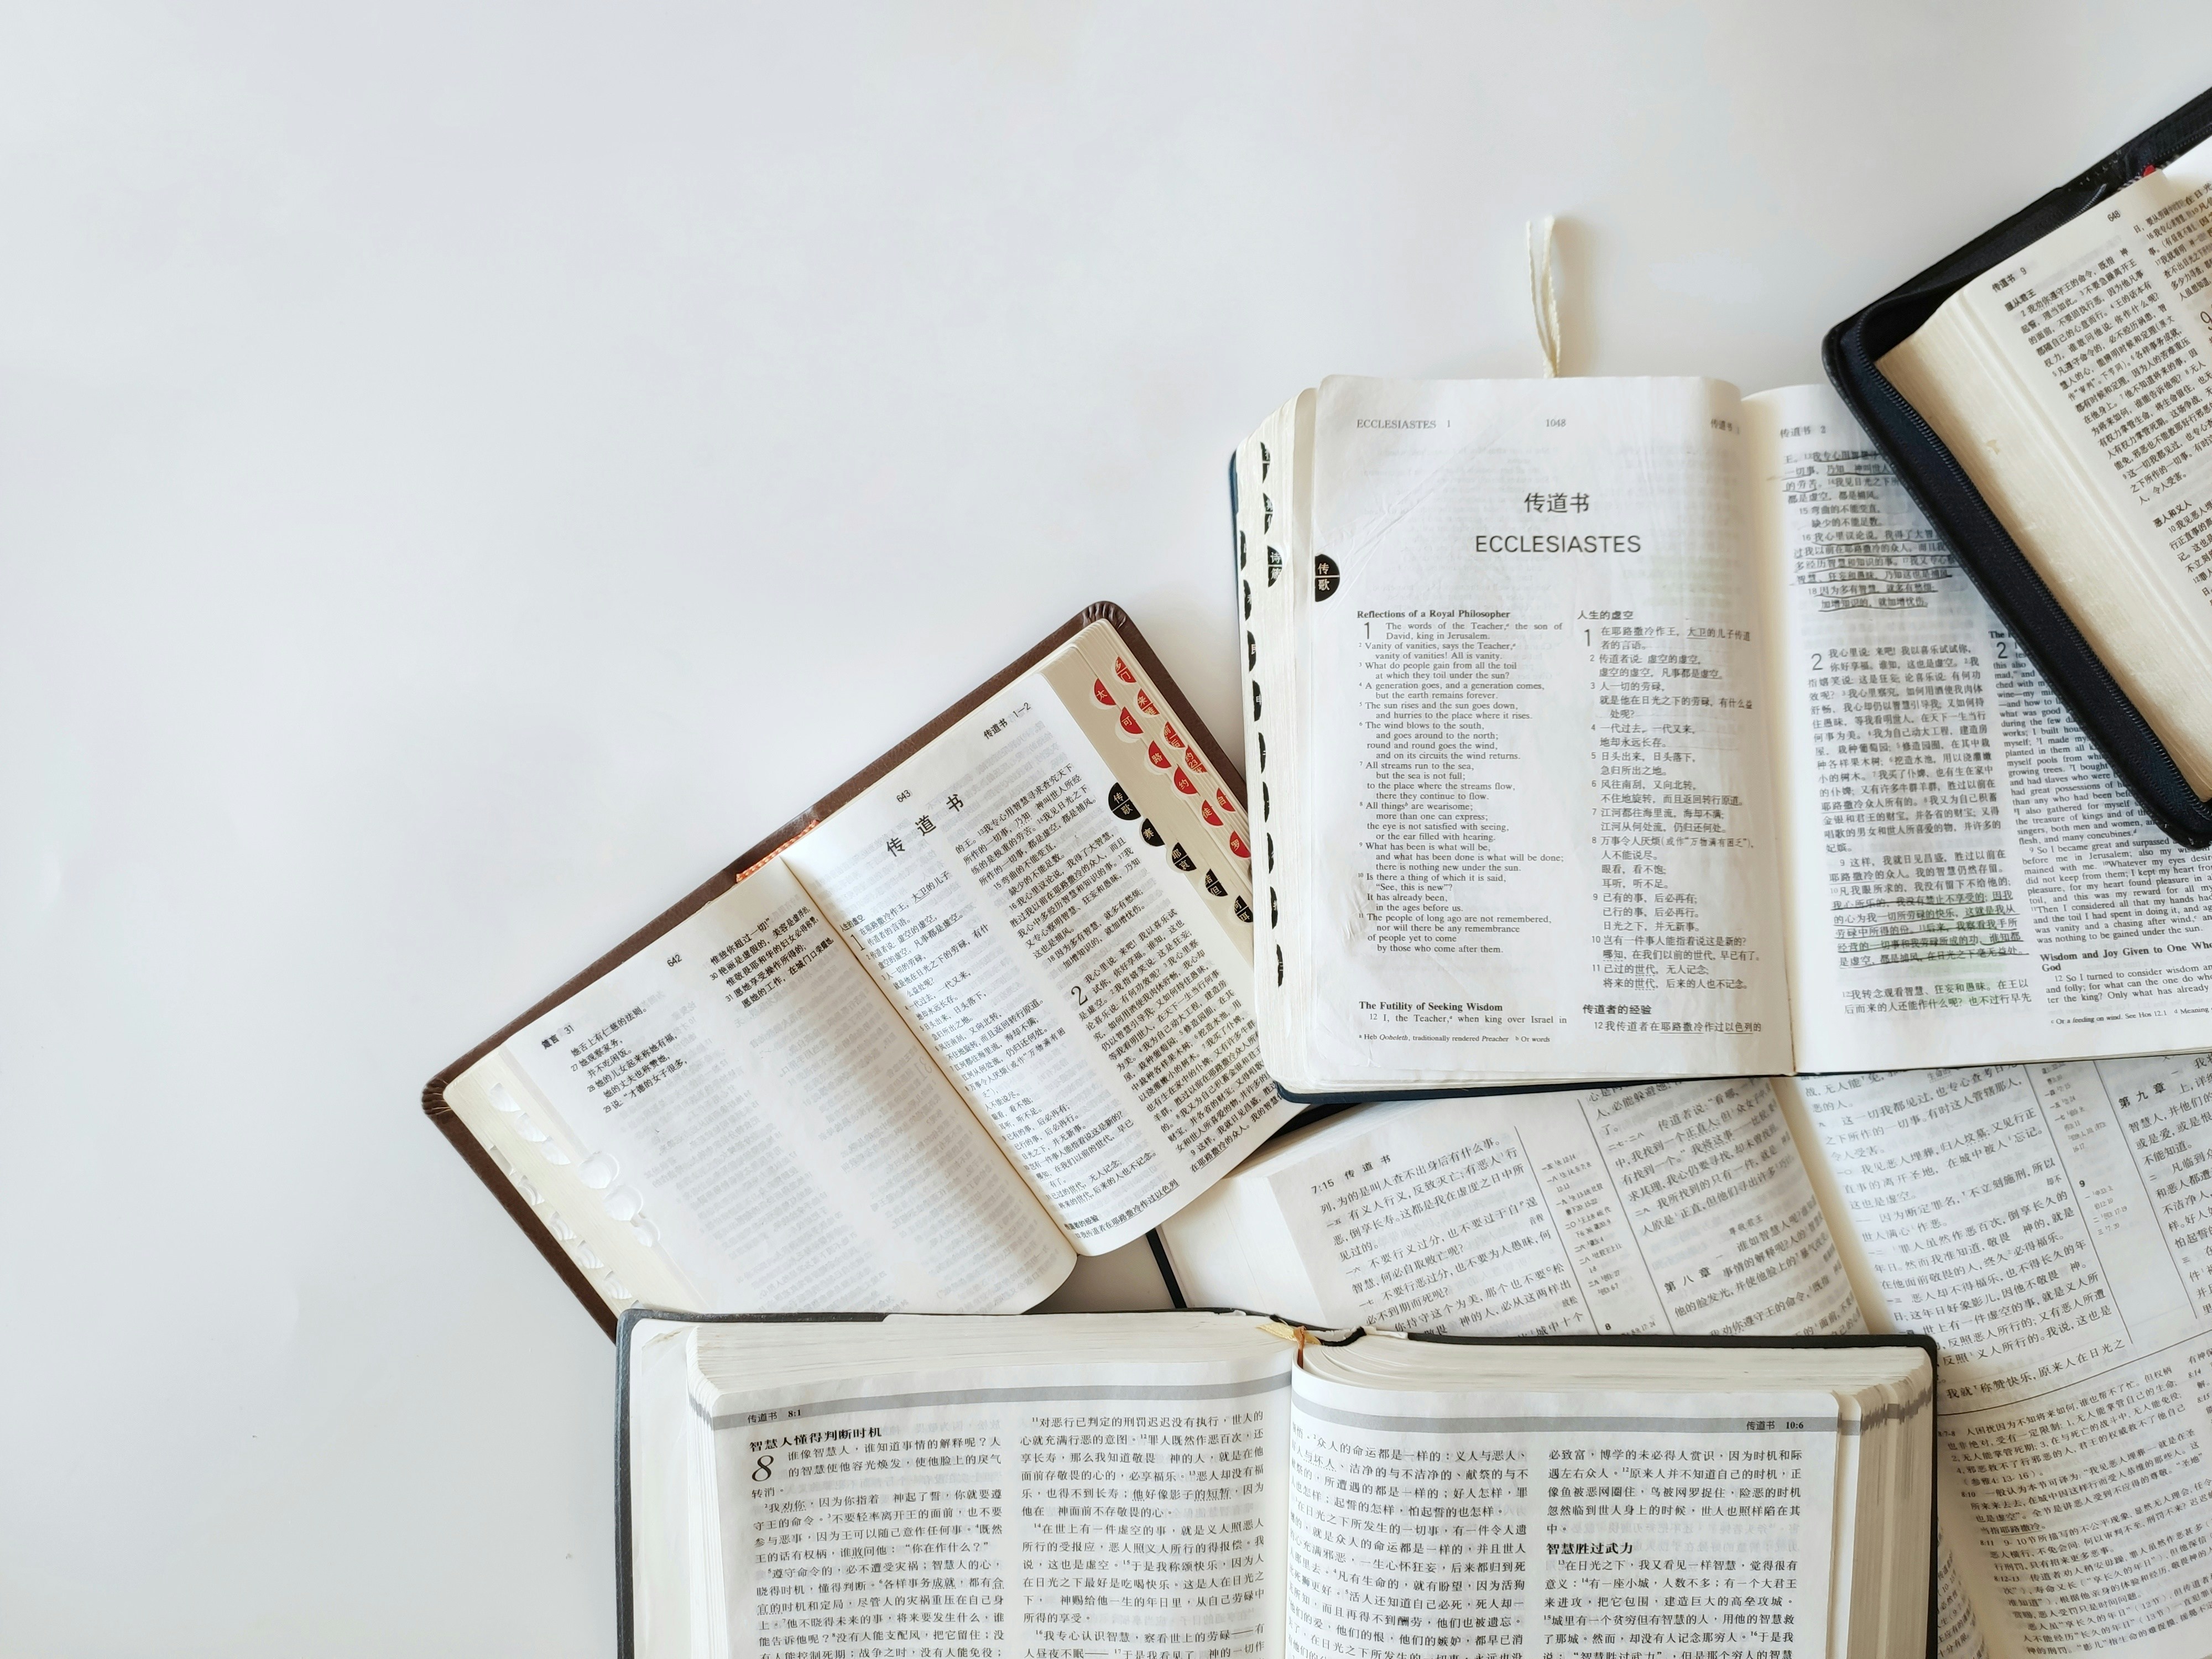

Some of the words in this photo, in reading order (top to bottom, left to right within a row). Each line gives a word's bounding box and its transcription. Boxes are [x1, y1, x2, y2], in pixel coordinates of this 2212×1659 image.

[2107, 210, 2121, 222] 648
[1991, 273, 2016, 293] 传道书
[2020, 267, 2027, 275] 9
[1357, 419, 1437, 429] ECCLESIASTES
[1546, 419, 1566, 427] 1048
[1524, 492, 1590, 514] 传道书
[2152, 500, 2193, 528] 恶人和义人
[1475, 535, 1641, 554] ECCLESIASTES
[1317, 563, 1330, 575] 传
[1317, 579, 1330, 591] 歌
[1357, 610, 1406, 619] Reflections
[1429, 610, 1455, 620] Royal
[1458, 610, 1511, 620] Philosopher
[1577, 610, 1634, 620] 人生的虚空
[1364, 622, 1370, 640] 1
[1386, 632, 1413, 641] David,
[1416, 632, 1434, 641] king
[1437, 632, 1445, 640] in
[1447, 632, 1490, 640] Jerusalem.
[1584, 629, 1590, 646] 1
[1600, 640, 1646, 650] 者的言语。
[1364, 661, 1387, 670] What
[1402, 661, 1431, 671] people
[1432, 661, 1450, 671] gain
[1488, 661, 1501, 670] the
[1503, 661, 1517, 670] toil
[1811, 653, 1823, 671] 2
[1375, 681, 1419, 691] generation
[1421, 683, 1443, 691] goes,
[1470, 681, 1514, 691] generation
[1096, 690, 1108, 701] 太
[1137, 696, 1147, 707] 来
[1375, 691, 1389, 700] but
[1392, 691, 1405, 699] the
[1407, 691, 1429, 699] earth
[1432, 691, 1464, 699] remains
[1466, 691, 1499, 699] forever.
[1121, 716, 1133, 726] 可
[983, 718, 1008, 740] 传道书
[1599, 737, 1667, 748] 地却永远长存。
[1151, 752, 1164, 765] 路
[1600, 765, 1667, 776] 急归所出之地。
[1178, 779, 1190, 790] 约
[896, 789, 913, 803] 643
[1113, 792, 1125, 804] 传
[1120, 803, 1134, 815] 歌
[1202, 807, 1213, 818] 徒
[886, 794, 964, 857] 传道书
[1143, 827, 1155, 840] 赛
[1230, 838, 1240, 852] 罗
[1171, 848, 1182, 859] 耶
[1601, 850, 1657, 860] 人不能说尽。
[1366, 893, 1375, 903] It
[1392, 893, 1423, 903] already
[1425, 893, 1448, 902] been,
[1375, 903, 1384, 911] in
[1386, 903, 1400, 911] the
[1402, 905, 1421, 914] ages
[1422, 903, 1449, 912] before
[2055, 933, 2087, 943] nothing
[2112, 928, 2140, 941] gained
[2141, 927, 2166, 936] under
[2168, 926, 2182, 934] the
[2039, 952, 2078, 962] Wisdom
[2081, 950, 2100, 959] and
[2103, 949, 2118, 959] Joy
[2122, 947, 2151, 956] Given
[2167, 944, 2188, 953] One
[666, 952, 683, 967] 642
[2041, 962, 2062, 972] God
[1358, 1001, 1377, 1010] The
[1379, 1001, 1413, 1012] Futility
[1416, 1001, 1426, 1011] of
[1428, 1001, 1463, 1013] Seeking
[1465, 1002, 1503, 1011] Wisdom
[1582, 1004, 1652, 1015] 传道者的经验
[541, 1034, 560, 1050] 箴言
[564, 1024, 575, 1035] 31
[570, 1063, 578, 1072] 27
[2118, 1082, 2167, 1110] 第九章
[2142, 1140, 2192, 1166] 不能知道。
[1311, 1178, 1334, 1194] 7:15
[1344, 1154, 1391, 1180] 传道书
[1664, 1266, 1712, 1294] 第八章
[1604, 1323, 1612, 1331] 8
[745, 1409, 780, 1426] 传道书
[786, 1407, 804, 1420] 8:1
[1745, 1418, 1777, 1433] 传道书
[1784, 1420, 1806, 1432] 10:6
[749, 1426, 883, 1453] 智慧人懂得判断时机
[751, 1454, 775, 1482] 8
[752, 1486, 784, 1499] 转消。
[1547, 1523, 1567, 1535] 中。
[1546, 1541, 1633, 1556] 智慧胜过武力
[1023, 1612, 1090, 1624] 所得的享受。
